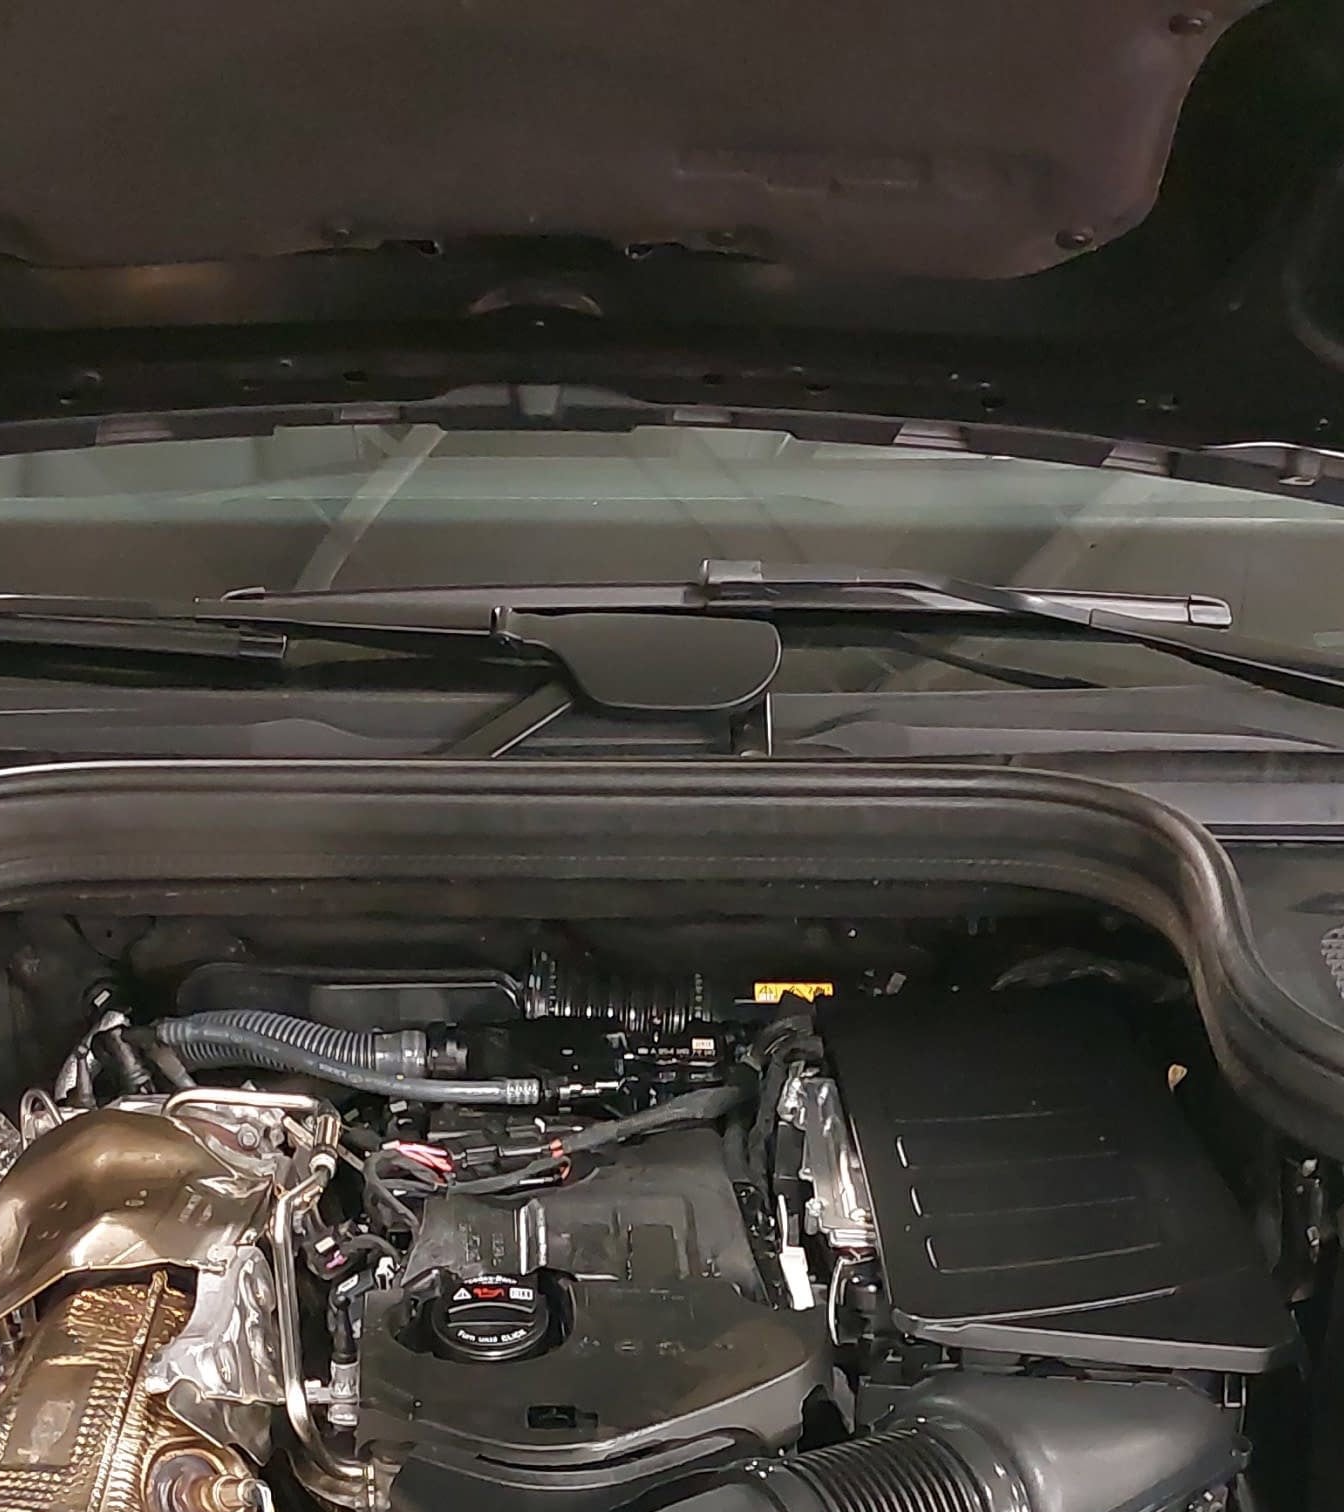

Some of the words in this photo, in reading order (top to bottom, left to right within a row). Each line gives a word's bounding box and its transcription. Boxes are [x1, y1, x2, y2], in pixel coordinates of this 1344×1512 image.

[457, 1329, 476, 1342] Turn
[478, 1335, 498, 1343] until
[501, 1328, 527, 1342] CLICK
